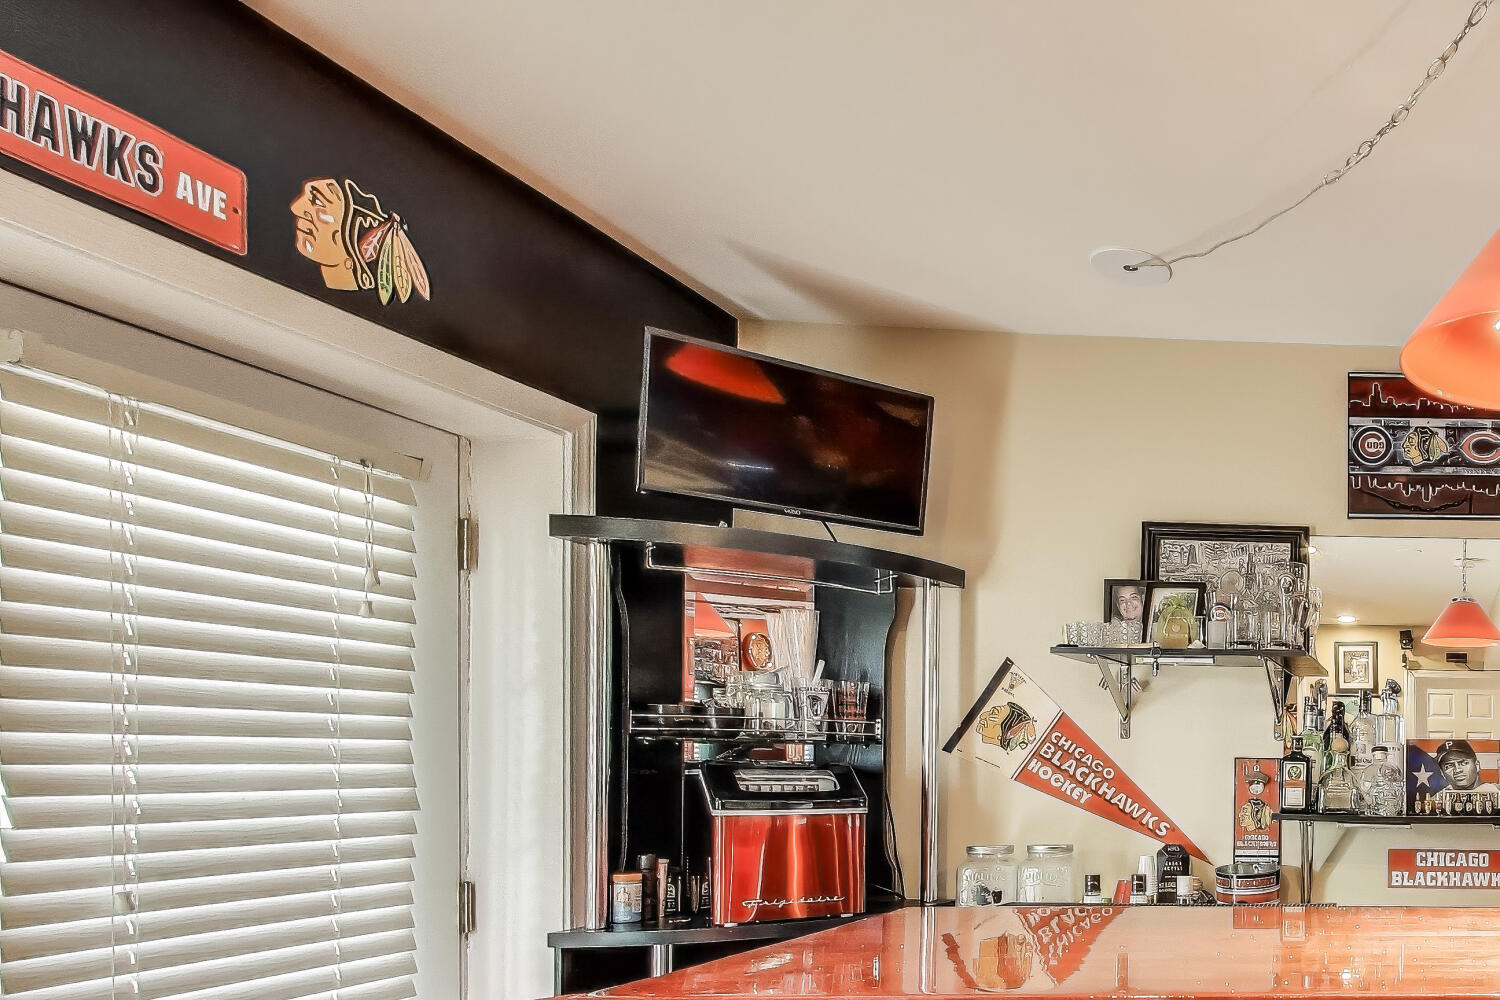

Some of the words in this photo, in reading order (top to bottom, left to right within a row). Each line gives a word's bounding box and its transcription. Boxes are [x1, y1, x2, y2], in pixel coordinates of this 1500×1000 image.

[176, 171, 228, 222] AVE
[1050, 731, 1116, 780] CHICAGO
[1026, 758, 1093, 804] HOCKEY
[1038, 742, 1172, 837] BLACKHAWKS
[1416, 851, 1489, 867] CHICAGO
[742, 895, 847, 909] Frigidaire
